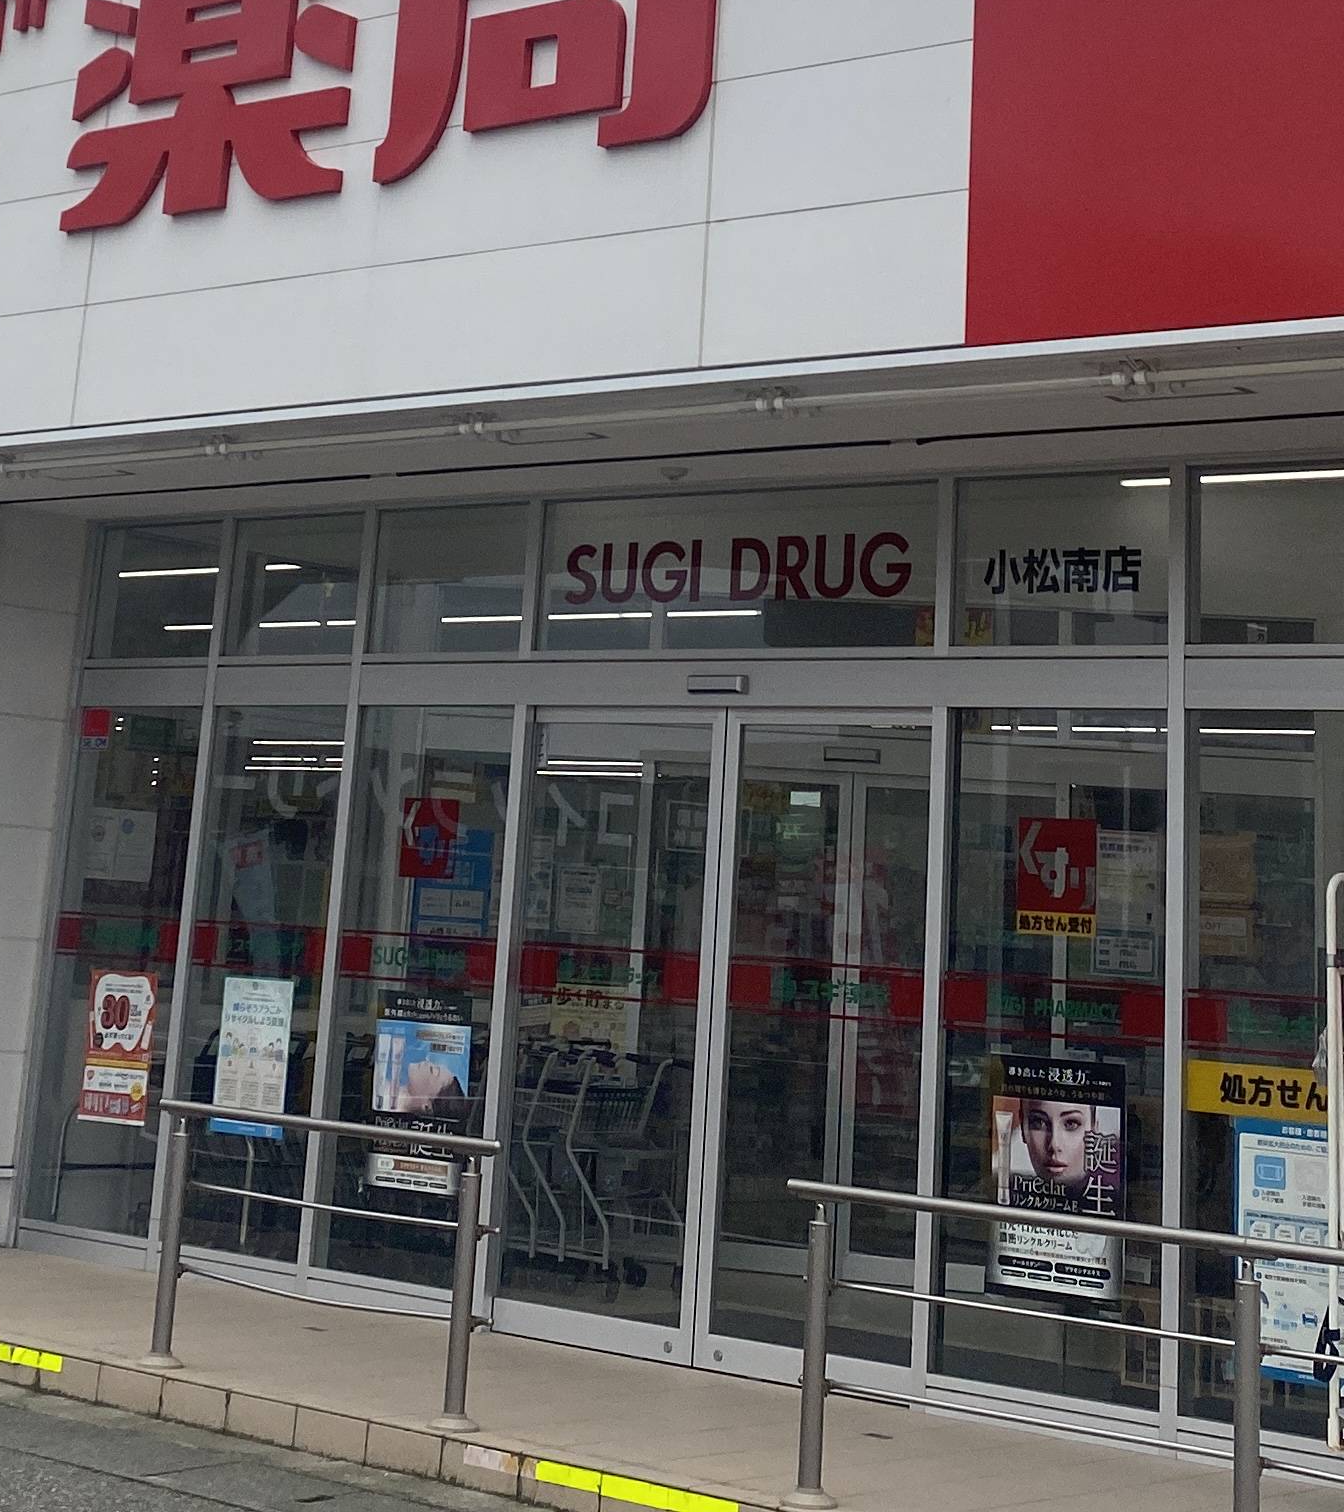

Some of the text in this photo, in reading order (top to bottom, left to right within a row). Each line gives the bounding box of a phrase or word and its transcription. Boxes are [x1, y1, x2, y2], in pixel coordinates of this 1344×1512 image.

[565, 532, 912, 605] SUGI DRUG
[984, 545, 1142, 595] 小松南店
[1020, 821, 1095, 911] くすり
[1019, 915, 1093, 934] 処方せん受付
[1082, 1129, 1117, 1217] 誕生
